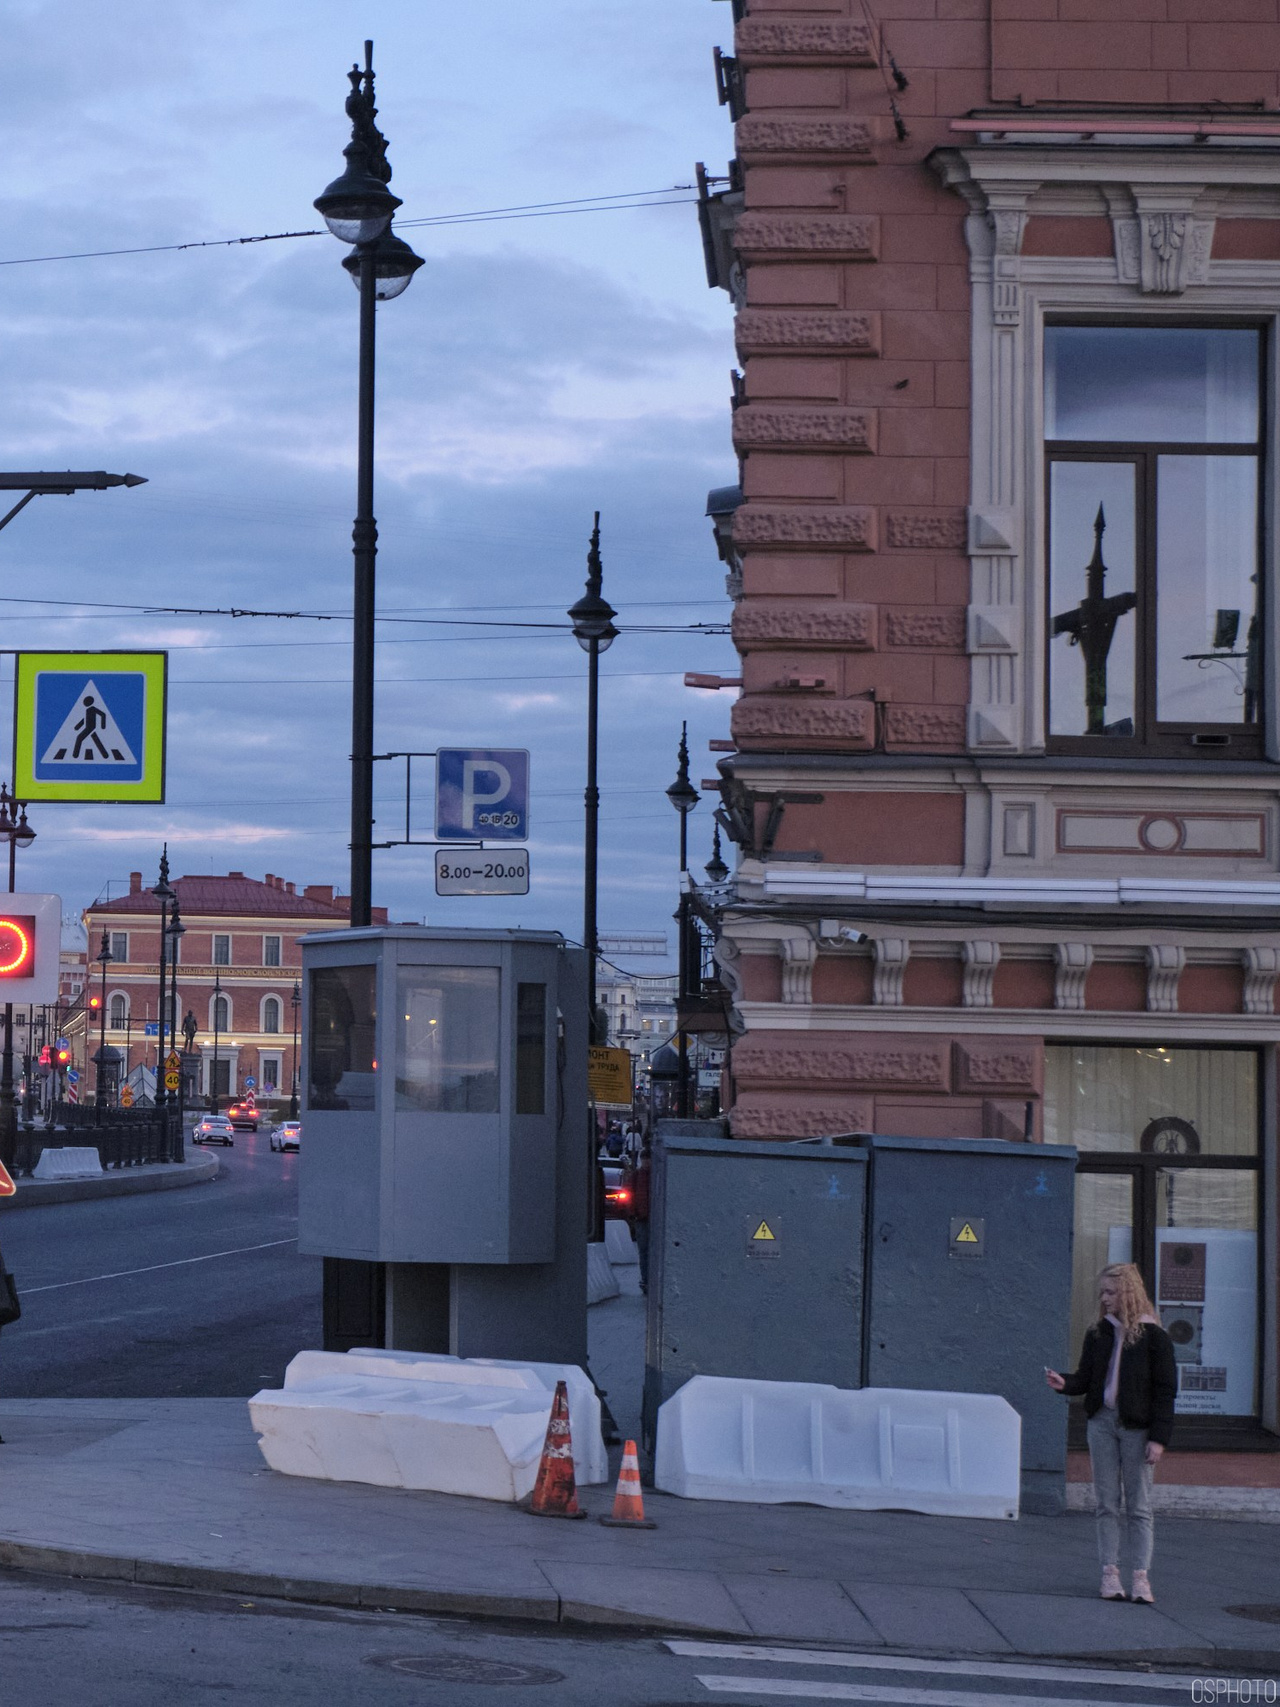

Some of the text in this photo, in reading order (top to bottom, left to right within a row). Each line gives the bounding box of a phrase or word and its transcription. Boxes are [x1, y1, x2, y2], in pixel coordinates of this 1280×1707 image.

[462, 760, 512, 829] P
[503, 814, 518, 825] 20
[145, 966, 201, 975] ЦЕНРАЛЬНЫЙ
[166, 1076, 179, 1085] 40
